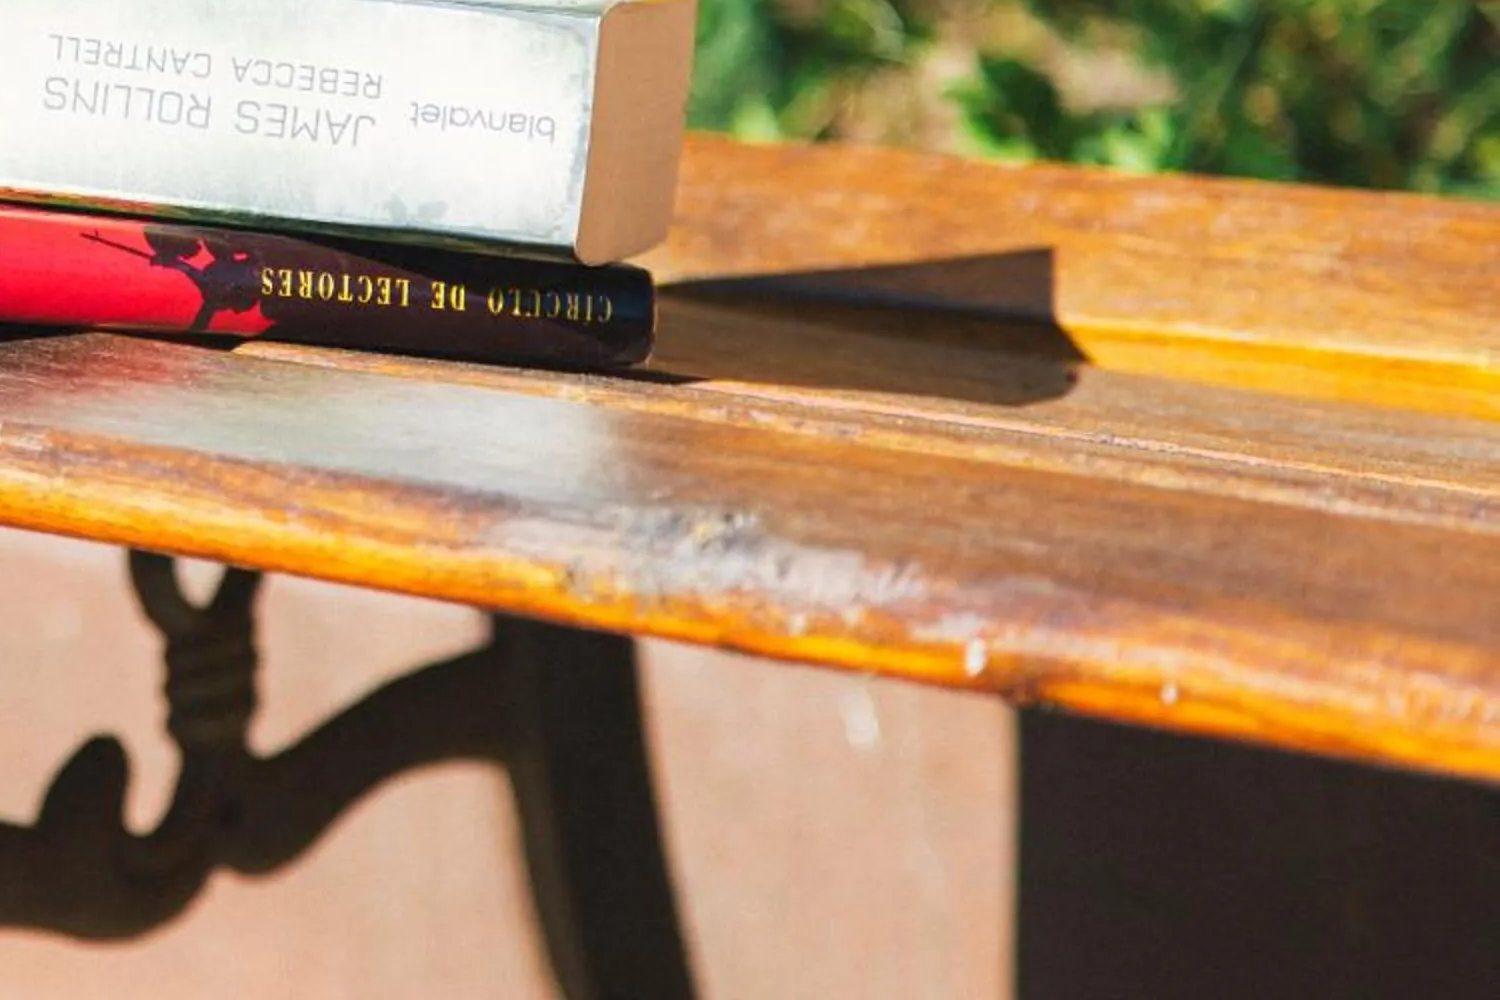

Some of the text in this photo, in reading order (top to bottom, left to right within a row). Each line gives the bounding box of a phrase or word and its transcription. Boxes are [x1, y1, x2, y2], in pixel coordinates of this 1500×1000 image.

[48, 34, 383, 99] REBECCA CANTRELL
[43, 76, 377, 146] JAMES ROLLINS
[409, 101, 556, 142] blanvalet
[260, 267, 411, 307] LECTORES
[431, 281, 466, 312] DE
